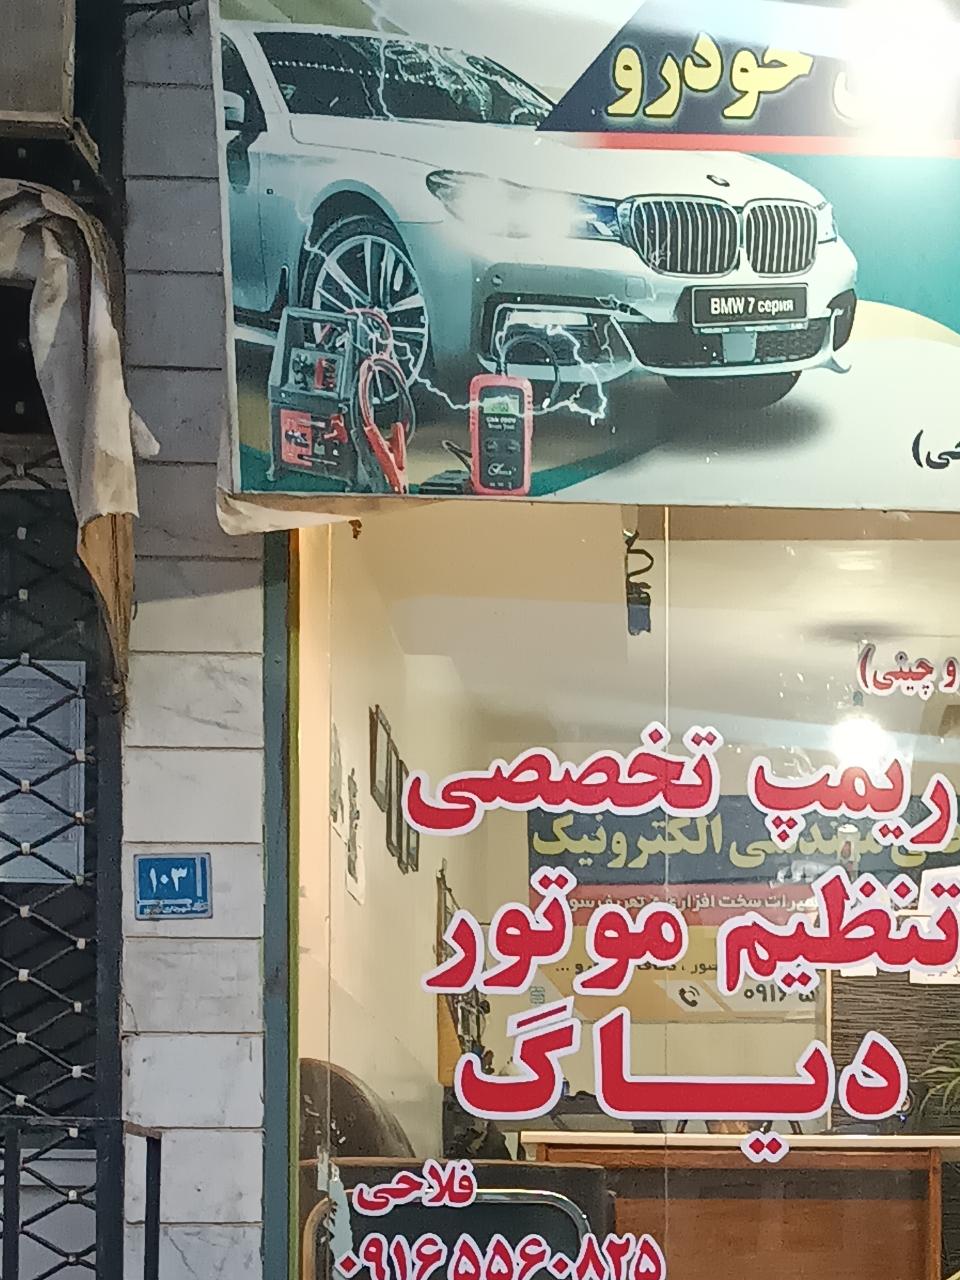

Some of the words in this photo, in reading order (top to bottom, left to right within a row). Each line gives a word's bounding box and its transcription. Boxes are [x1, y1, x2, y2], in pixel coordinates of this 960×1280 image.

[606, 31, 815, 119] خودرو
[710, 297, 745, 315] BMW
[747, 297, 756, 313] 7
[942, 657, 959, 691] و
[404, 724, 719, 834] تخصصی
[751, 750, 955, 845] ریمپ
[532, 812, 724, 869] الکترونیک
[149, 867, 188, 894] ۱۰۳
[718, 894, 761, 911] سخت
[424, 870, 686, 991] موتور
[354, 1159, 477, 1214] فلاحی
